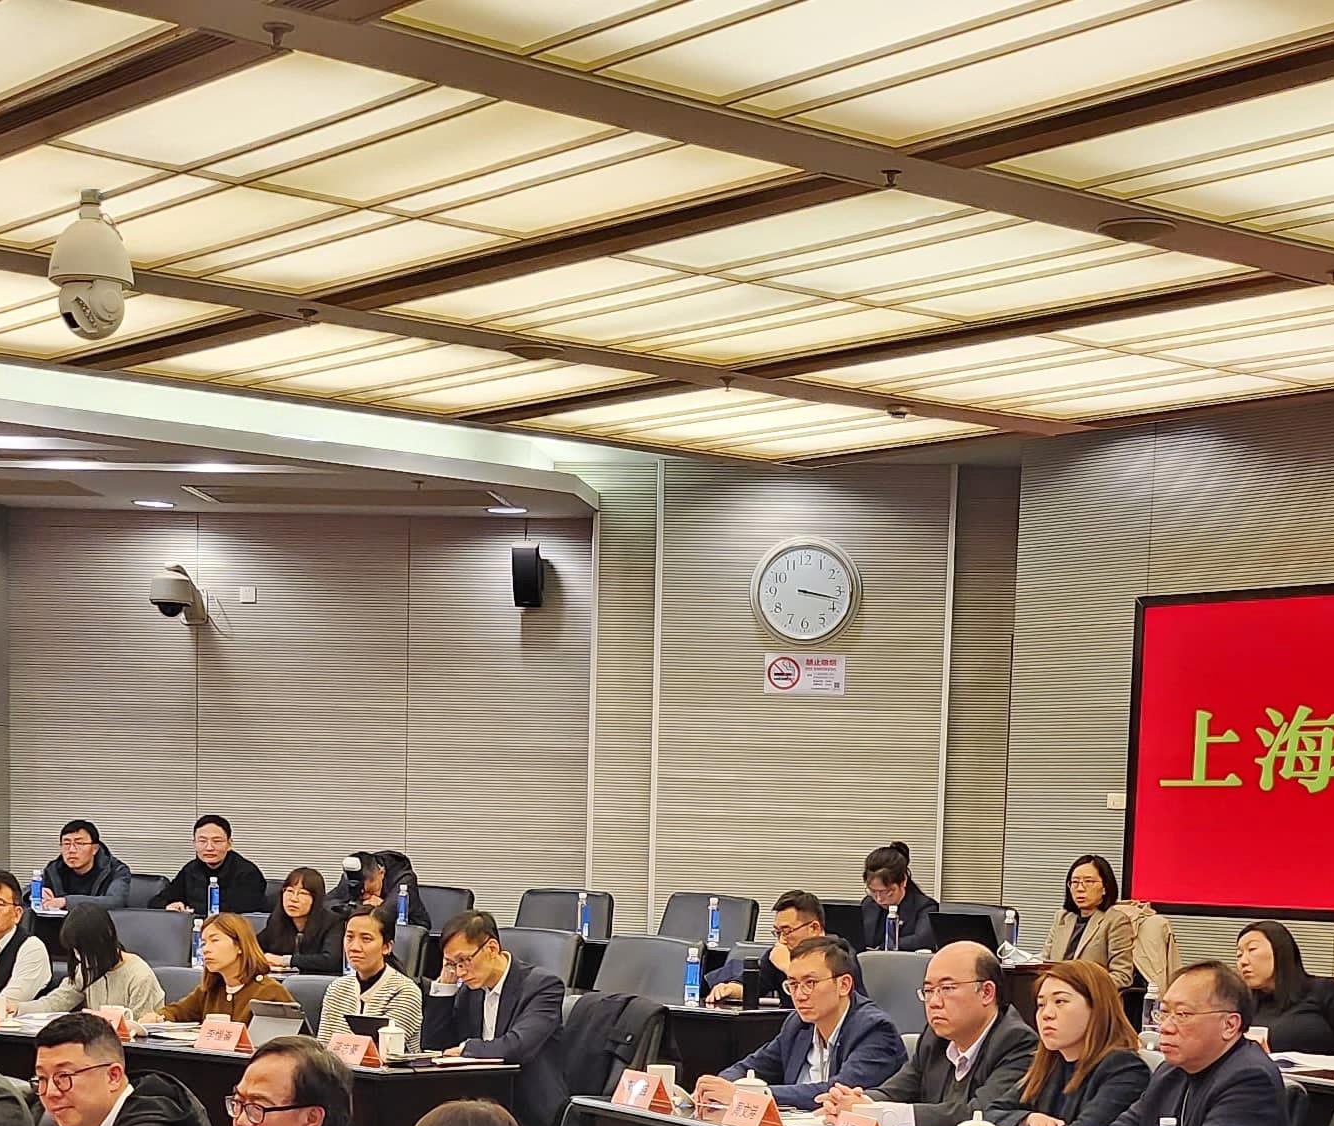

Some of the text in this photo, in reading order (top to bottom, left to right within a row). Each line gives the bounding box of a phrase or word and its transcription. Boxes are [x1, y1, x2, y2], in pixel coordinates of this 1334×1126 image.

[786, 559, 796, 571] 11
[800, 554, 812, 566] 12
[775, 572, 787, 584] 10
[827, 568, 836, 580] 2
[769, 585, 778, 597] 9
[835, 585, 842, 597] 3
[774, 602, 782, 614] 8
[828, 600, 836, 612] 4
[787, 613, 795, 625] 7
[801, 617, 809, 629] 6
[819, 613, 826, 625] 5
